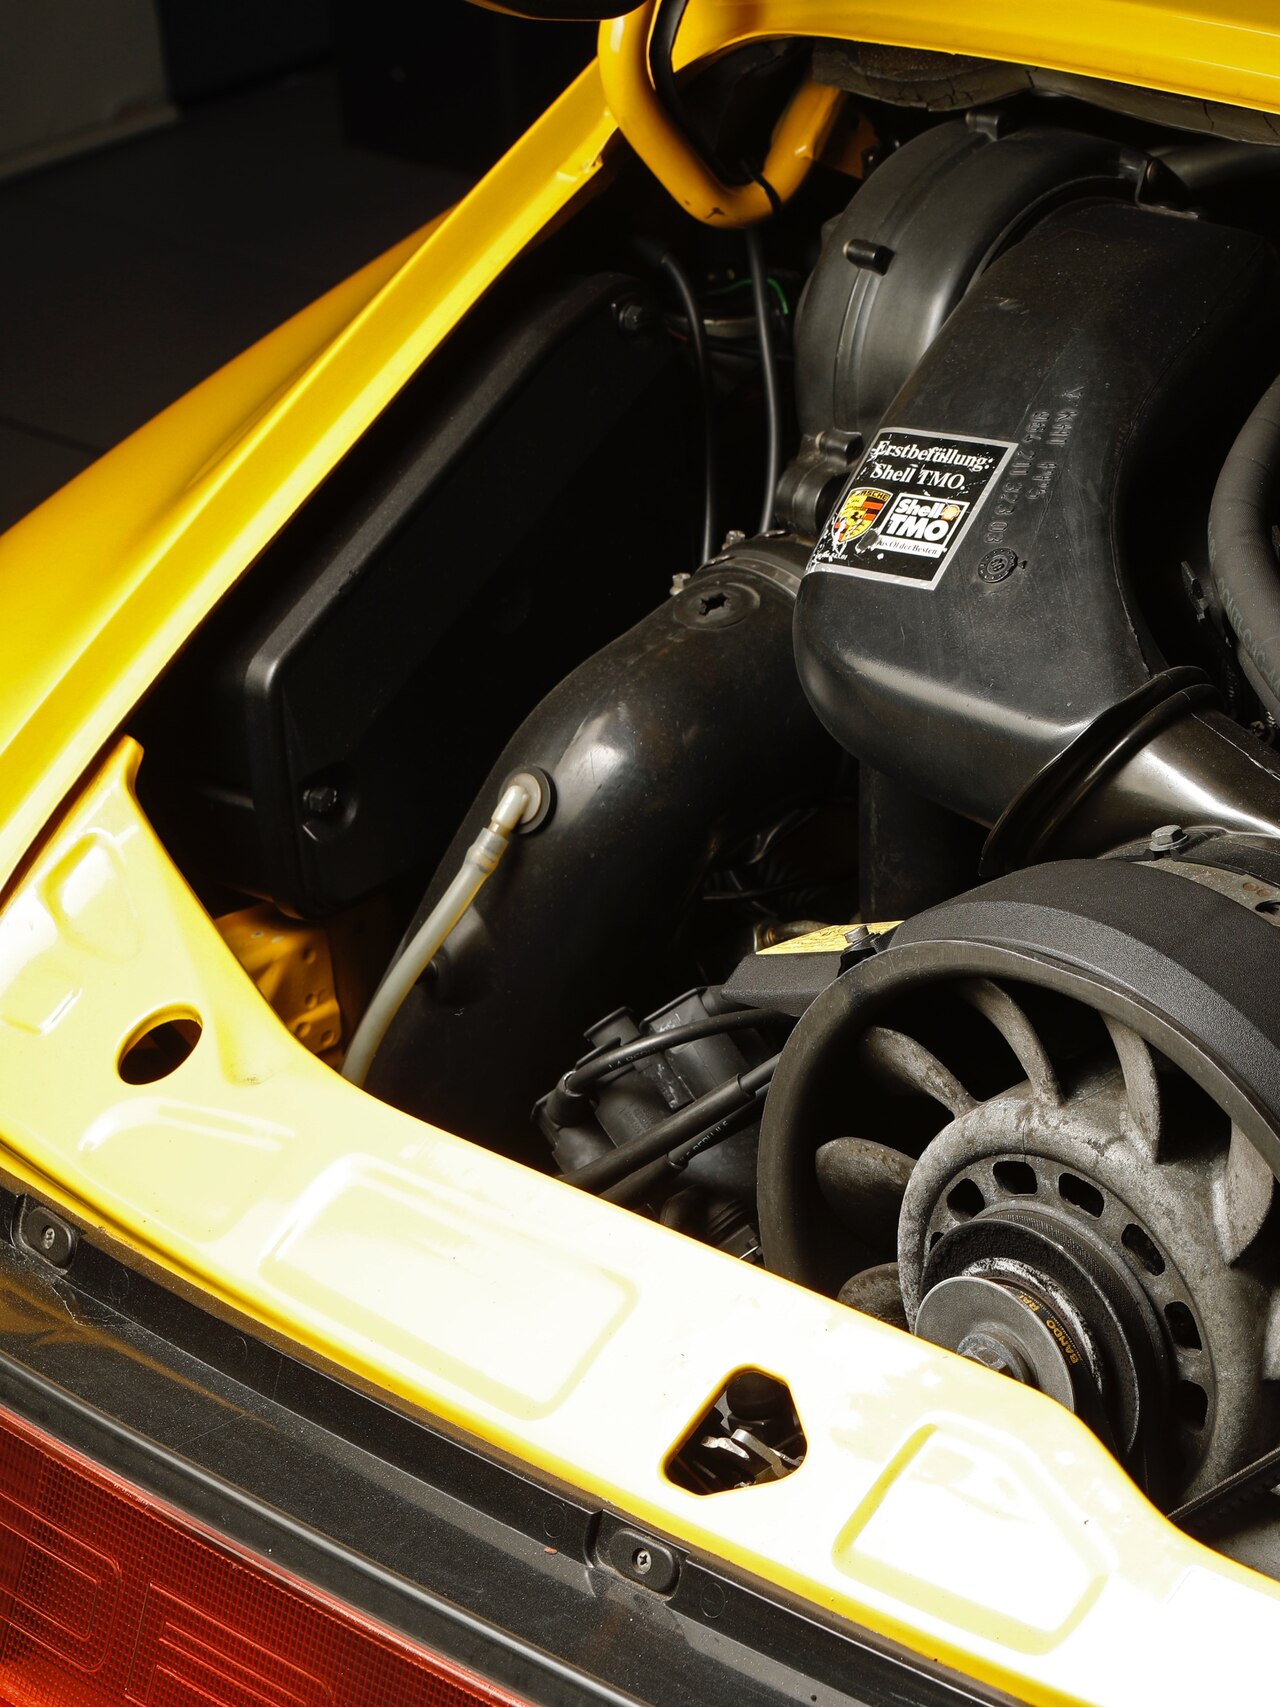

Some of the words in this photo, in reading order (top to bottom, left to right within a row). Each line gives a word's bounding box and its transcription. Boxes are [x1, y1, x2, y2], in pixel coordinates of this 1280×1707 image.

[874, 440, 994, 472] Erstbefüllung:
[870, 462, 917, 484] Shell
[917, 468, 966, 491] TMO.
[895, 498, 942, 518] Shell
[886, 514, 949, 541] TMO
[1045, 1319, 1080, 1364] BANDO
